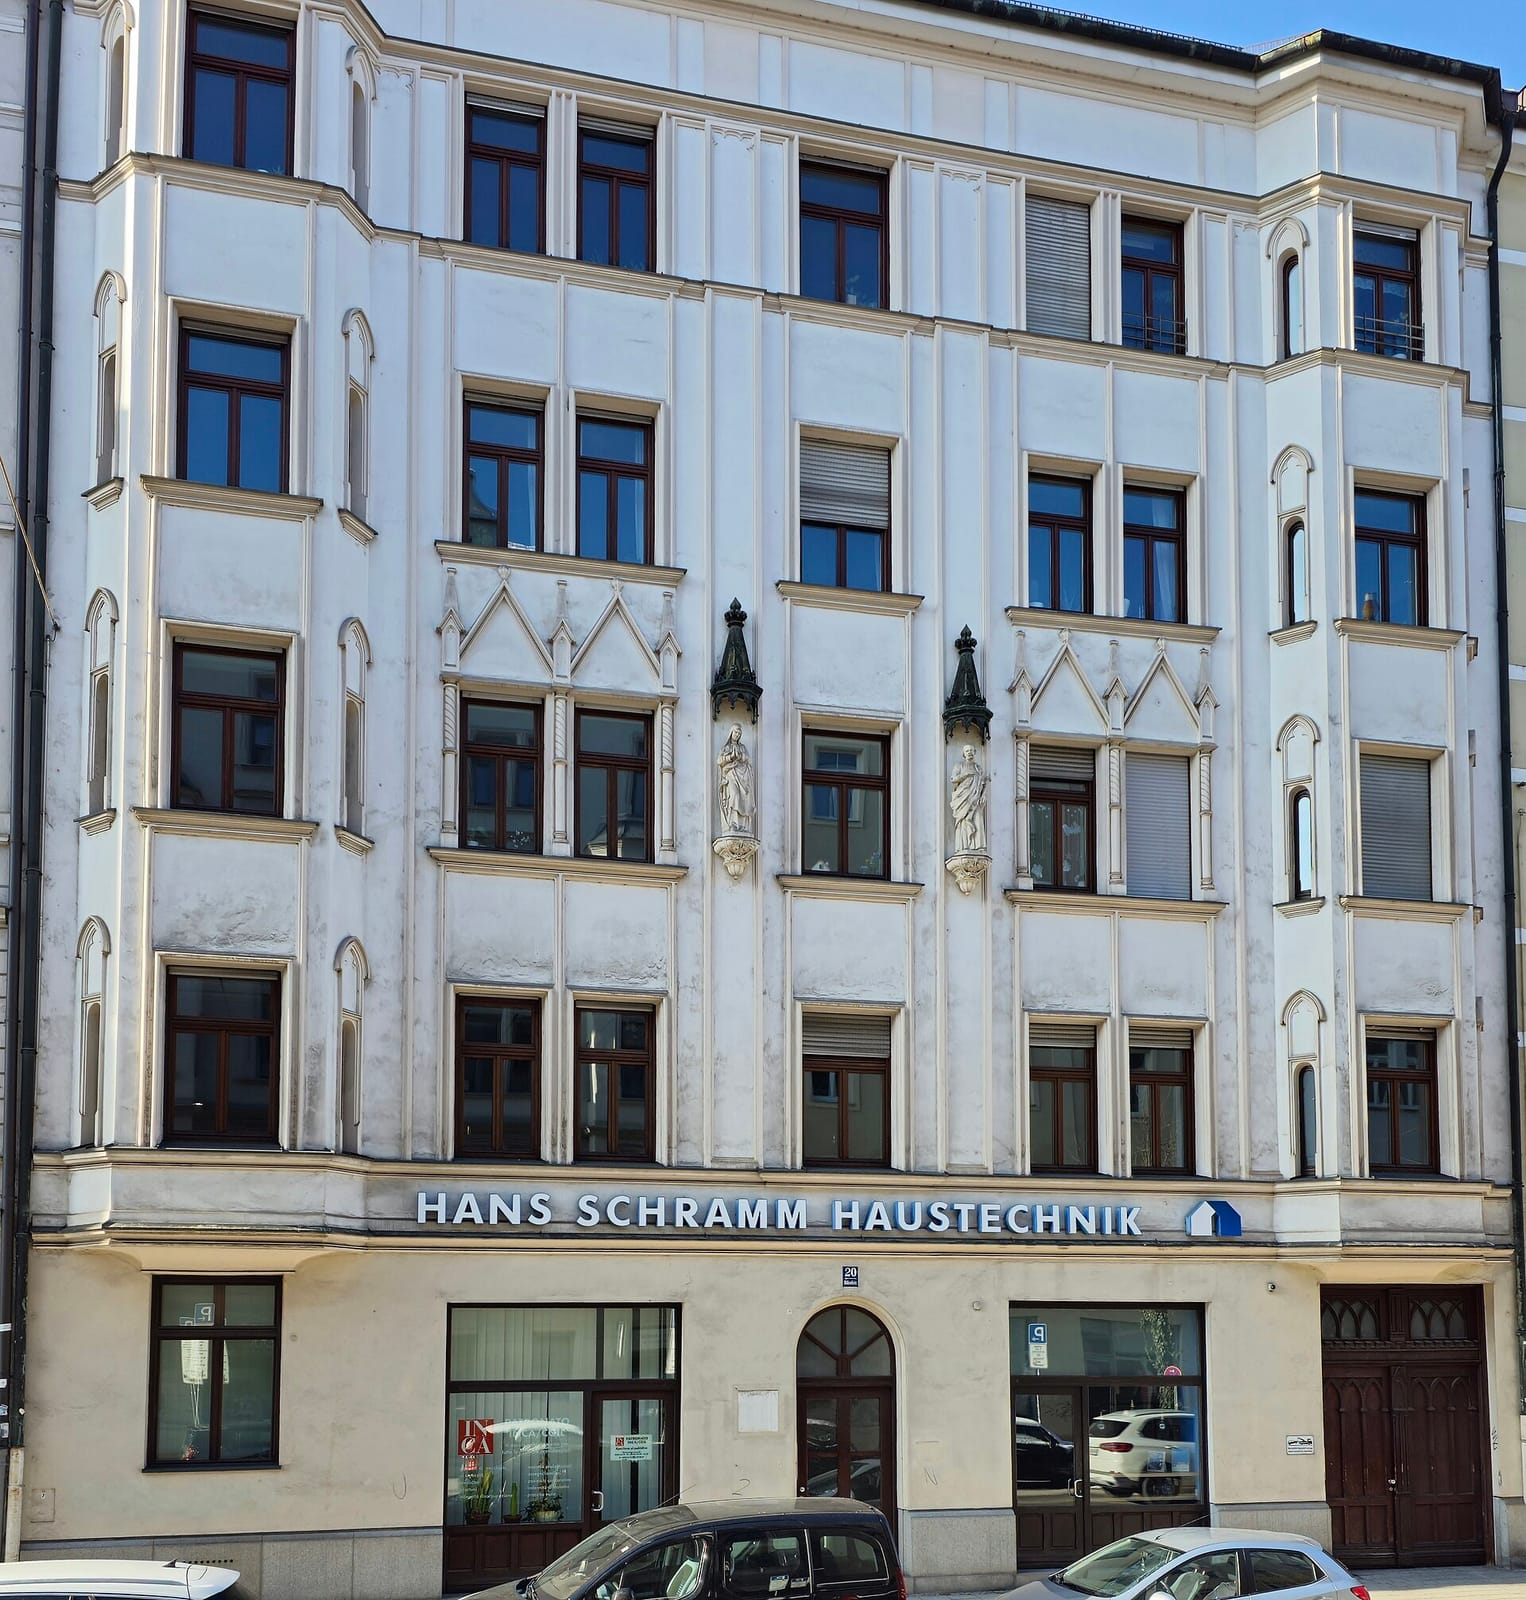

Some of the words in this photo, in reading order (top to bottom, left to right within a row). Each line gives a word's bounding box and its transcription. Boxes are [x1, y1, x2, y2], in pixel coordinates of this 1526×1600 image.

[416, 1191, 552, 1226] HANS
[576, 1194, 808, 1230] SCHRAMM
[832, 1199, 1143, 1236] HAUSTECHNIK
[844, 1266, 857, 1277] 20
